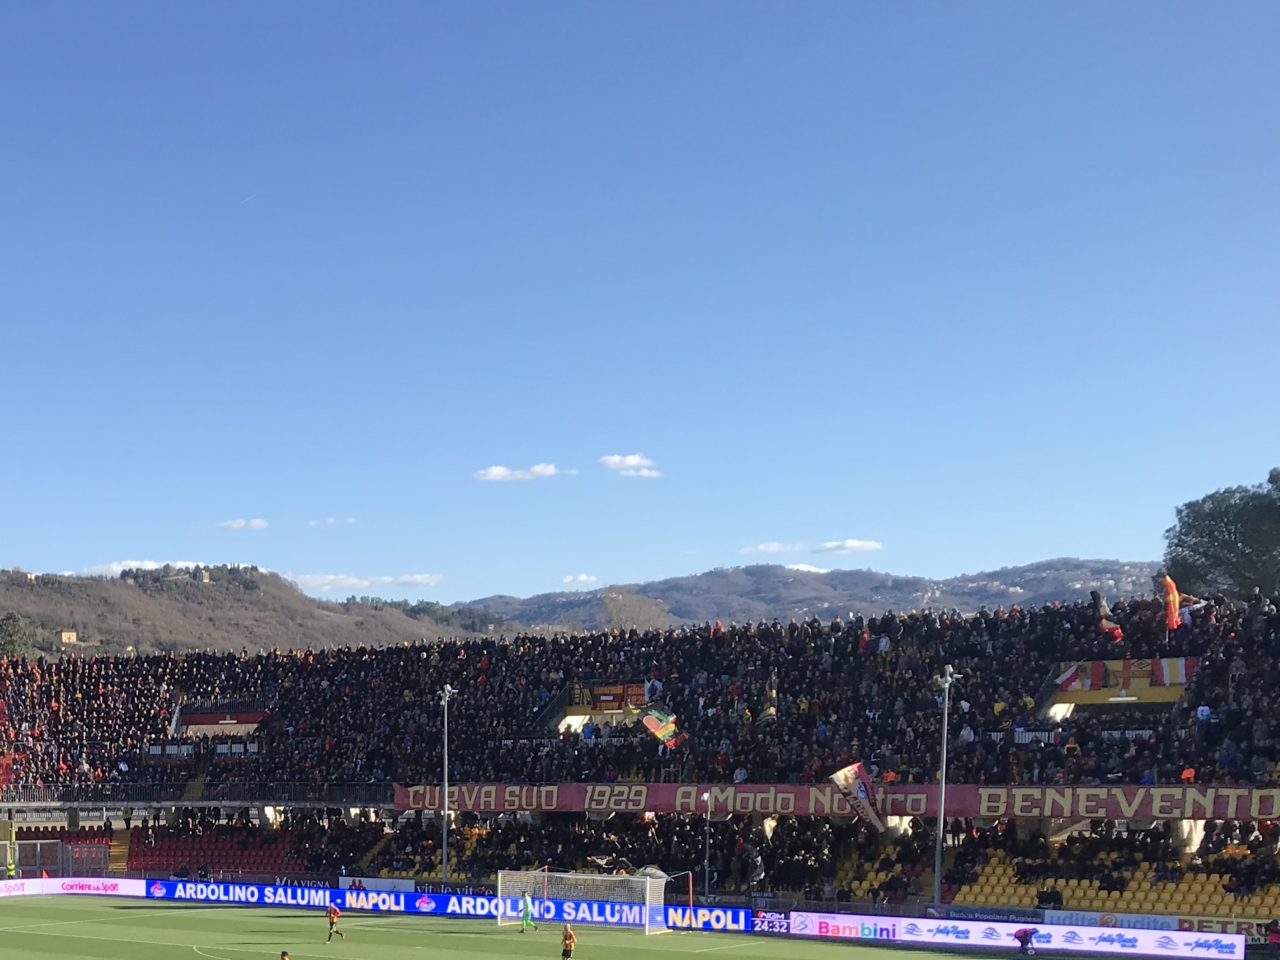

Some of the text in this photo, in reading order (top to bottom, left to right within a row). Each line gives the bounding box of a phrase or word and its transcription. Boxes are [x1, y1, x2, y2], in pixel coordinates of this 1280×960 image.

[504, 785, 559, 810] SUD
[584, 784, 647, 811] 1929
[709, 786, 795, 814] Modo
[808, 786, 928, 815] Notro
[978, 786, 1280, 818] BENEVENTO
[61, 881, 92, 892] Corriere
[175, 883, 259, 902] ARDOLINO
[263, 888, 330, 907] SALUMI
[345, 892, 405, 911] NAPOLI
[562, 902, 645, 924] SALUMI
[668, 908, 745, 930] NAPOLI
[753, 920, 788, 933] 24:32
[818, 920, 897, 939] Bambini
